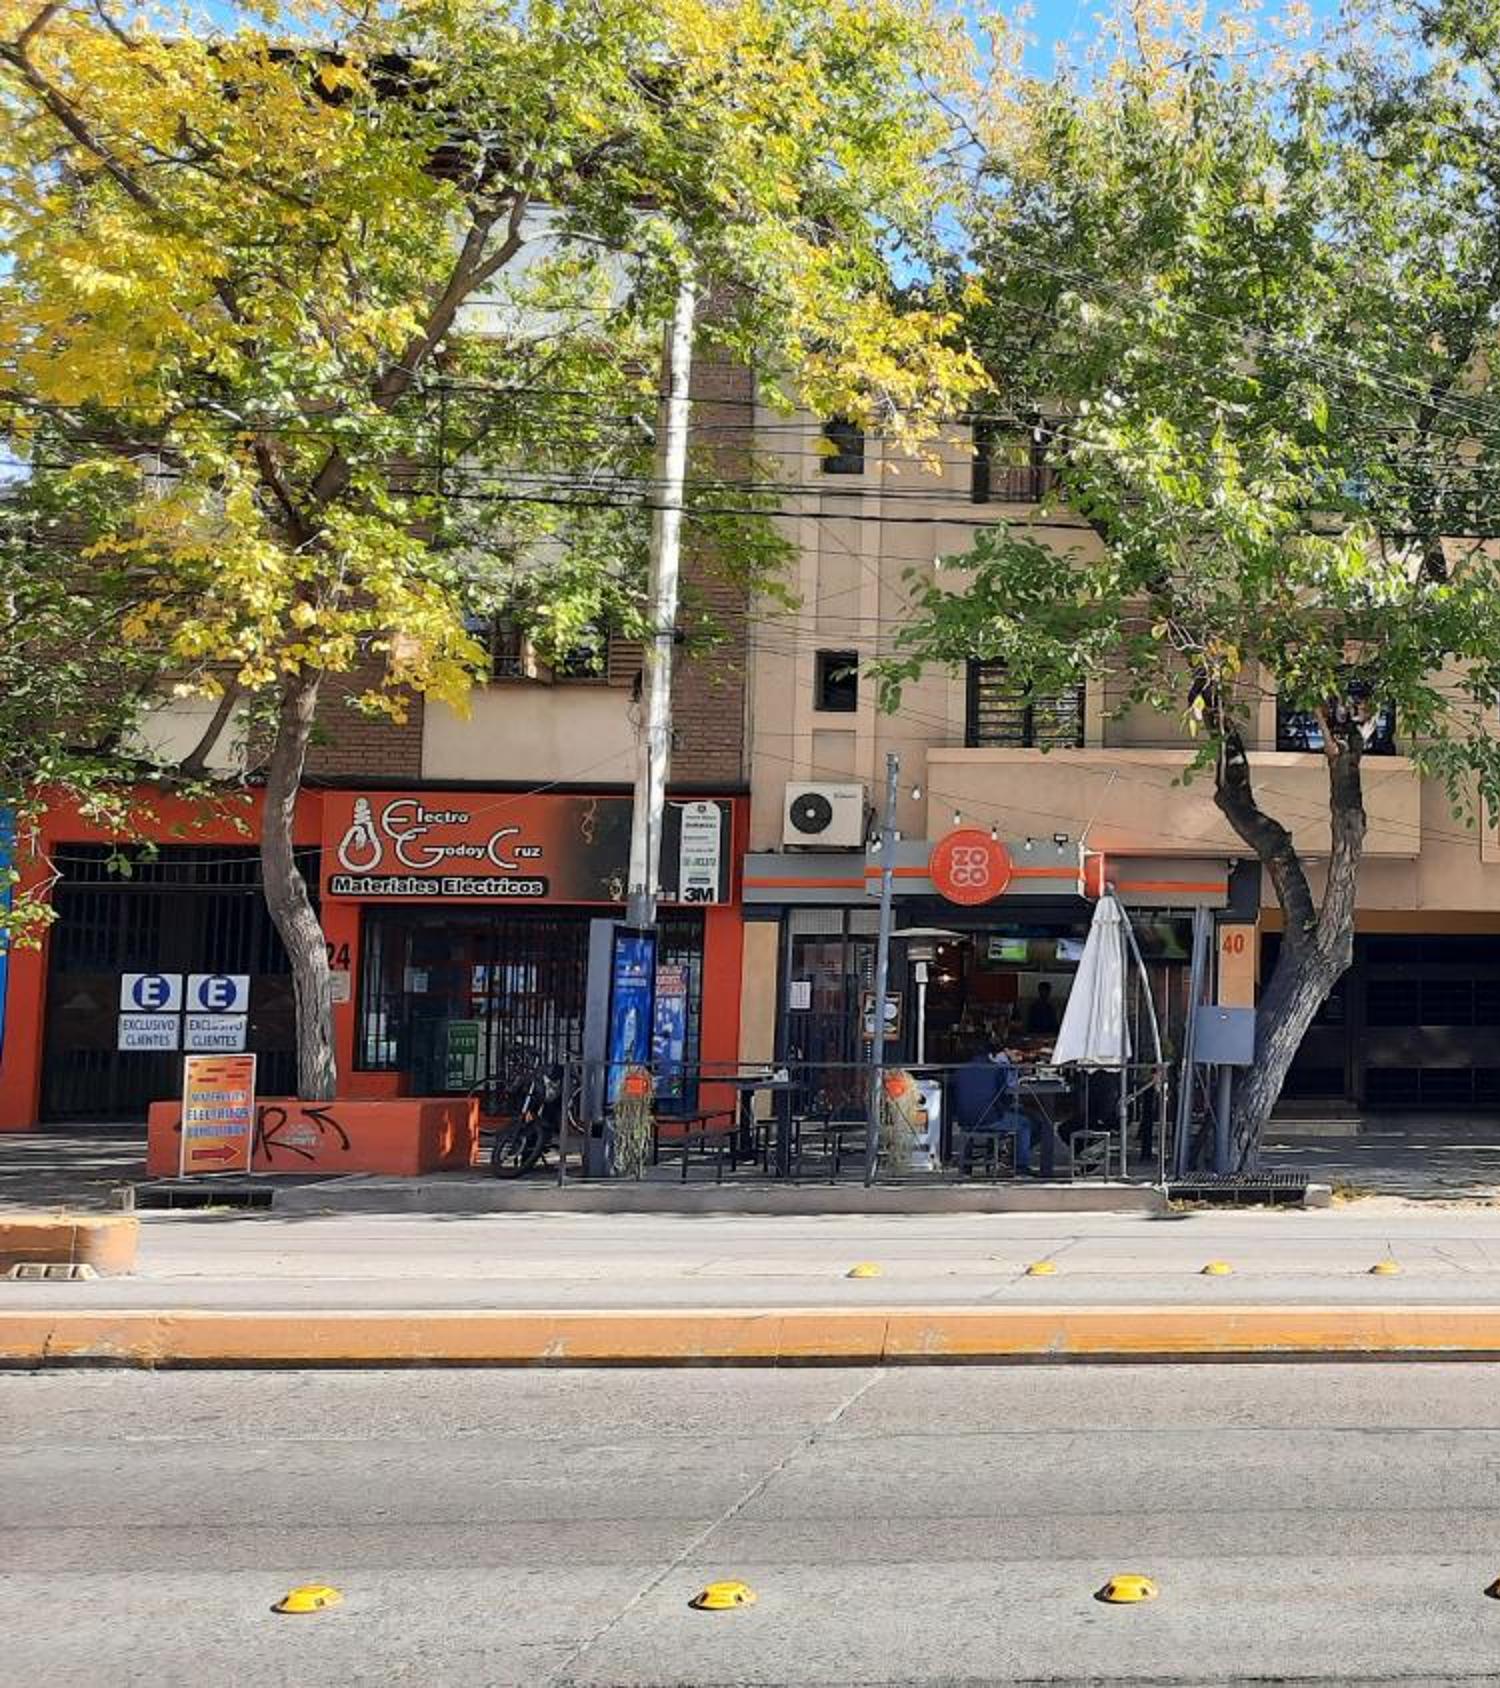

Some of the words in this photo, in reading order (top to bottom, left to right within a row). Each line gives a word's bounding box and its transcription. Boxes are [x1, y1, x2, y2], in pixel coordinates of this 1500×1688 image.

[382, 799, 469, 840] Electro
[396, 827, 484, 868] Godoy
[487, 827, 543, 869] Cruz
[331, 876, 438, 895] Materiales
[684, 887, 715, 903] 3M
[1222, 934, 1244, 954] 40
[142, 977, 160, 1005] E
[207, 979, 227, 1007] E
[123, 1019, 175, 1031] EXCLUSIVO
[126, 1034, 169, 1047] CLIENTES
[192, 1035, 237, 1047] CLIENTES
